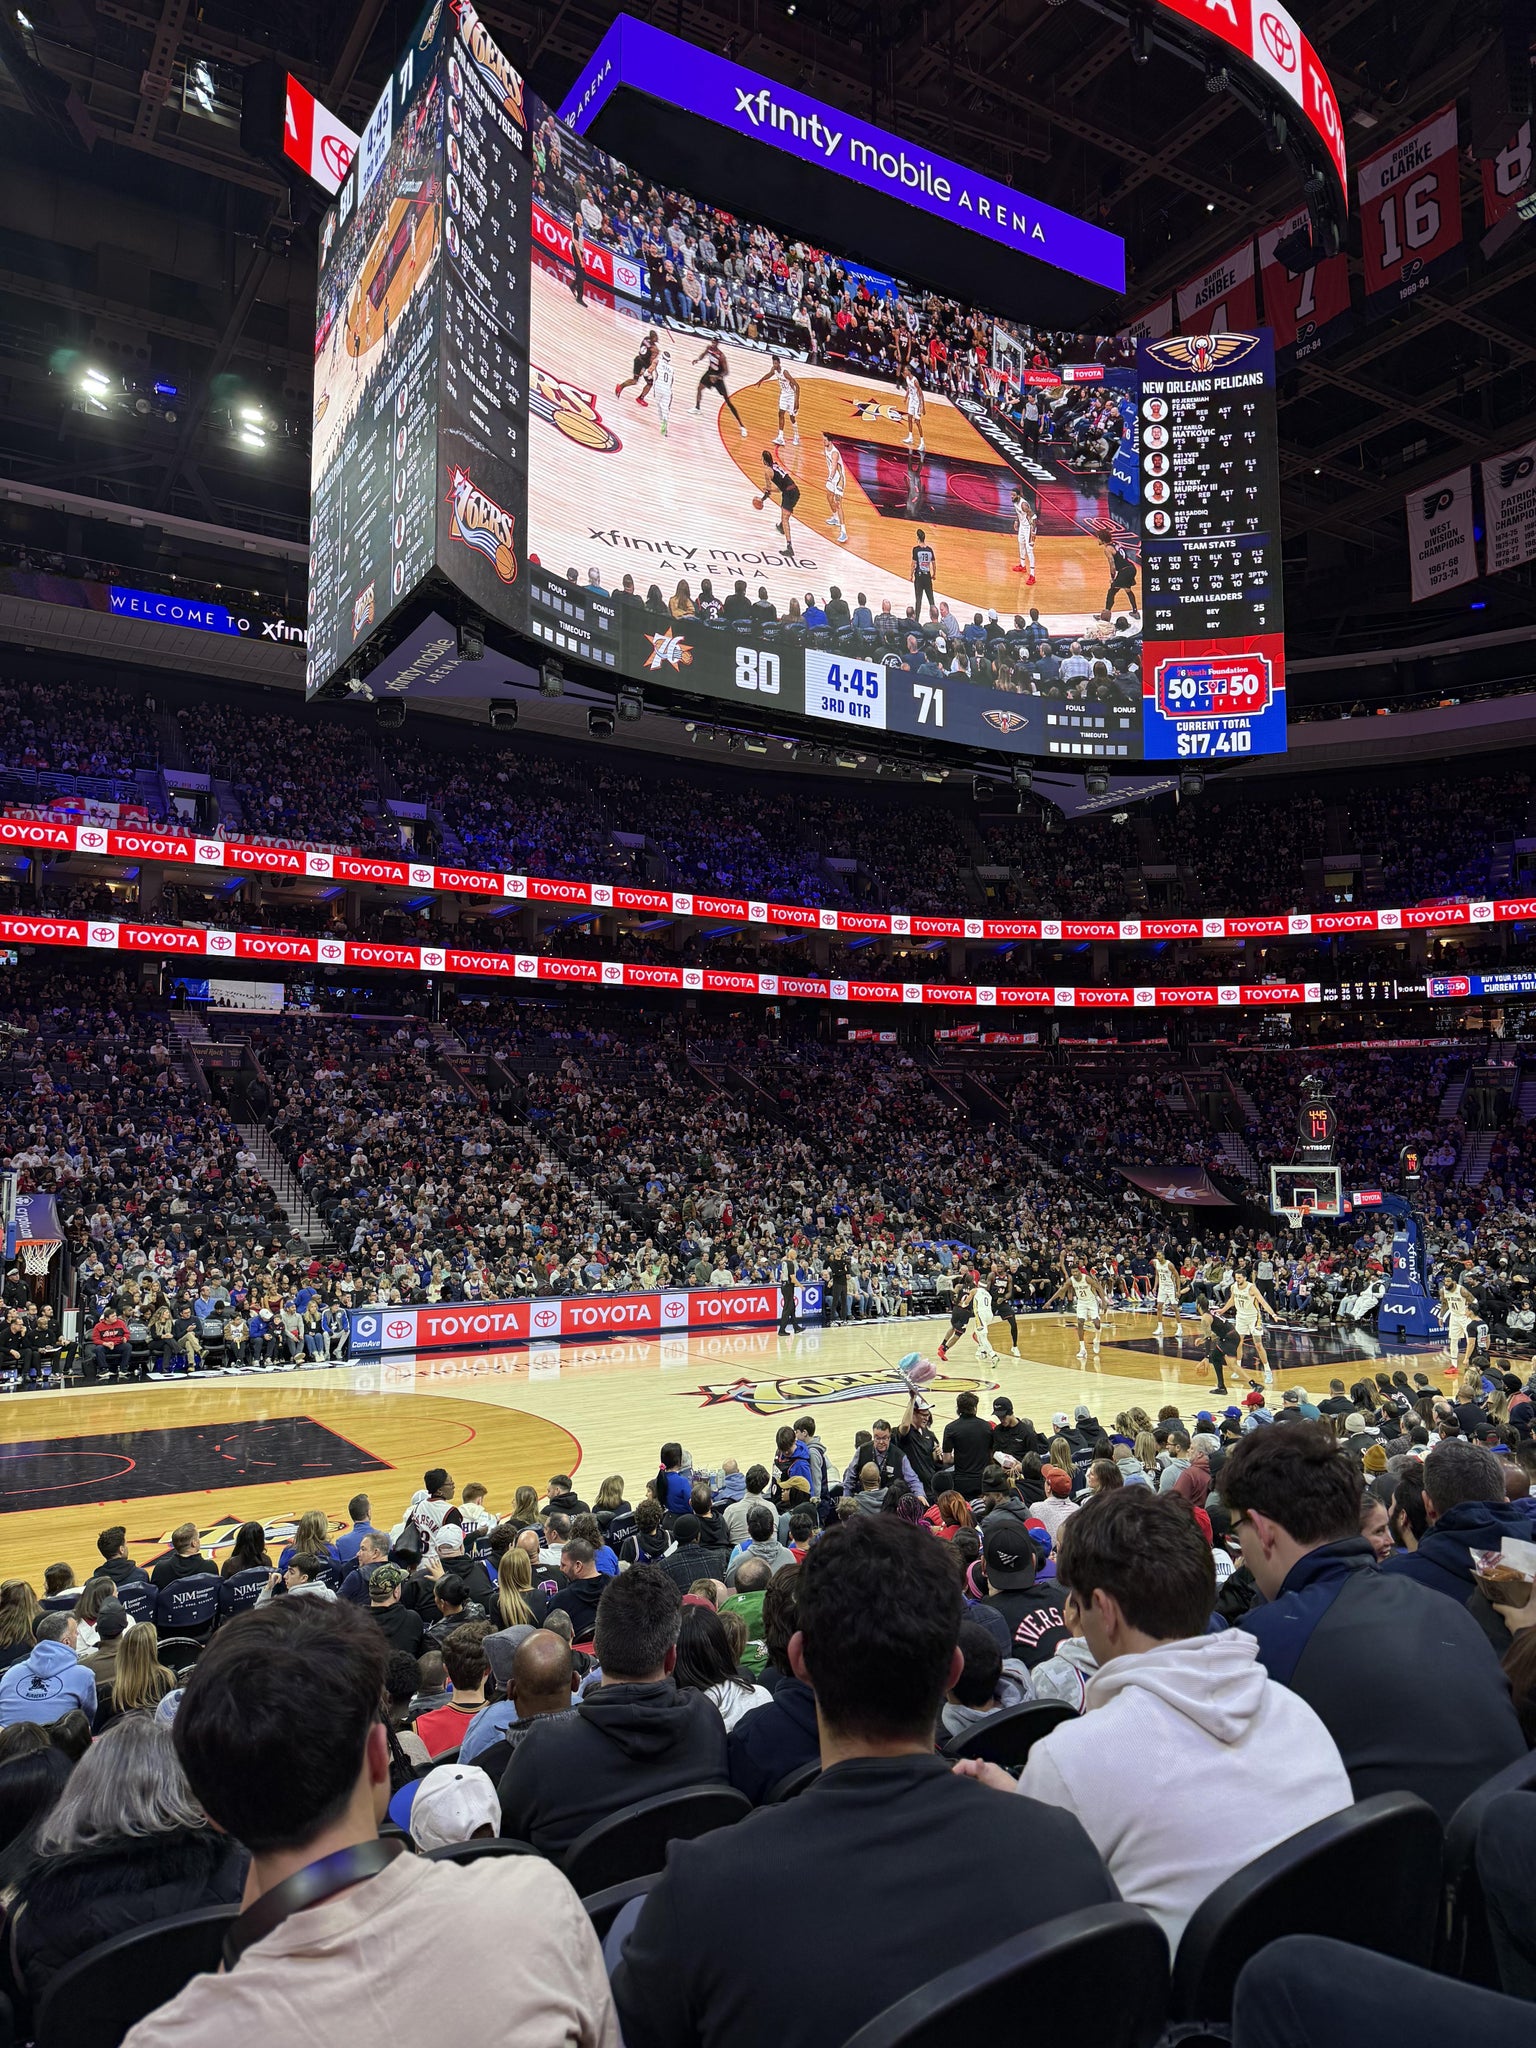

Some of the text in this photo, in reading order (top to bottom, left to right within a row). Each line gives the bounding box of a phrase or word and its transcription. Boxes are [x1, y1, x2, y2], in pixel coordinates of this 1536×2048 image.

[400, 49, 413, 105] 71
[453, 36, 497, 120] PHILADELPHIA
[497, 108, 523, 150] 76ERS
[577, 59, 612, 119] ARENA
[367, 94, 389, 155] 4:45
[1392, 137, 1419, 163] BOBBY
[735, 87, 1045, 243] xfinity mobile ARENA
[1380, 142, 1432, 188] CLARKE
[339, 172, 354, 228] 80
[1379, 174, 1441, 270] 16
[1204, 266, 1225, 287] BARRY
[1399, 276, 1430, 300] 1969-84
[1195, 269, 1237, 309] ASHBEE
[465, 290, 499, 336] TEAM STATS
[461, 359, 501, 408] TEAM LEADERS
[1143, 372, 1263, 394] NEW ORLEANS PELICANS
[1172, 403, 1196, 411] FEARS
[1172, 429, 1216, 438] MATKOVIC
[975, 415, 1057, 480] crypto.com
[1174, 485, 1208, 493] MURPHY
[1175, 516, 1189, 524] BEY
[1430, 520, 1451, 537] WEST
[587, 527, 818, 570] xfinity mobile
[1183, 540, 1236, 551] TEAM STATS
[1419, 535, 1465, 560] CHAMPIONS
[1424, 528, 1459, 549] DIVISION
[660, 560, 769, 579] ARENA
[548, 582, 567, 597] FOULS
[1205, 592, 1242, 602] LEADERS
[110, 595, 250, 631] WELCOME TO
[593, 602, 615, 617] BONUS
[1253, 604, 1265, 612] 25
[559, 620, 591, 640] TIMEOUTS
[1259, 617, 1265, 625] 3
[412, 638, 455, 669] mobile
[425, 658, 463, 684] ARENA
[735, 646, 780, 695] 80
[827, 664, 879, 699] 4:45
[1208, 666, 1248, 675] Foundation
[1168, 674, 1259, 699] 50 50
[821, 697, 871, 719] 3RD QTR
[913, 684, 944, 727] 71
[1175, 697, 1252, 708] RAFFLE
[1177, 718, 1251, 731] CURRENT TOTAL
[1177, 731, 1251, 756] $17,410
[0, 824, 1465, 935] OYOTA TOYOTA TOYOTA TOYOTA TOYOTA TOYOTA TOYOTA TOYOTA TOYOTA TOYOTA TOYOTA TOYOTA TOYOTA TOYOTA TOYOTA TOYOTA TOYOTA
[1, 921, 1300, 1002] TOYOTA TOYOTA TOYOTA TOYOTA TOYOTA TOYOTA TOYOTA TOYOTA TOYOTA TOYOTA TOYOTA TOYOTA TOYOTA TOYOTA TOYOTA
[1433, 984, 1444, 992] 50
[1455, 982, 1466, 990] 50
[1484, 983, 1519, 992] CURRENT
[1309, 1110, 1327, 1120] 4:45
[1312, 1120, 1327, 1138] 14
[1407, 1242, 1418, 1283] xfinity
[570, 1303, 652, 1326] TOYOTA
[696, 1293, 771, 1318] TOYOTA
[427, 1313, 519, 1337] TOYOTA
[351, 1340, 381, 1349] ComAve
[613, 1527, 630, 1540] NJM
[172, 1590, 196, 1604] NJM
[233, 1582, 257, 1597] NJM
[1015, 1606, 1064, 1648] IVERS
